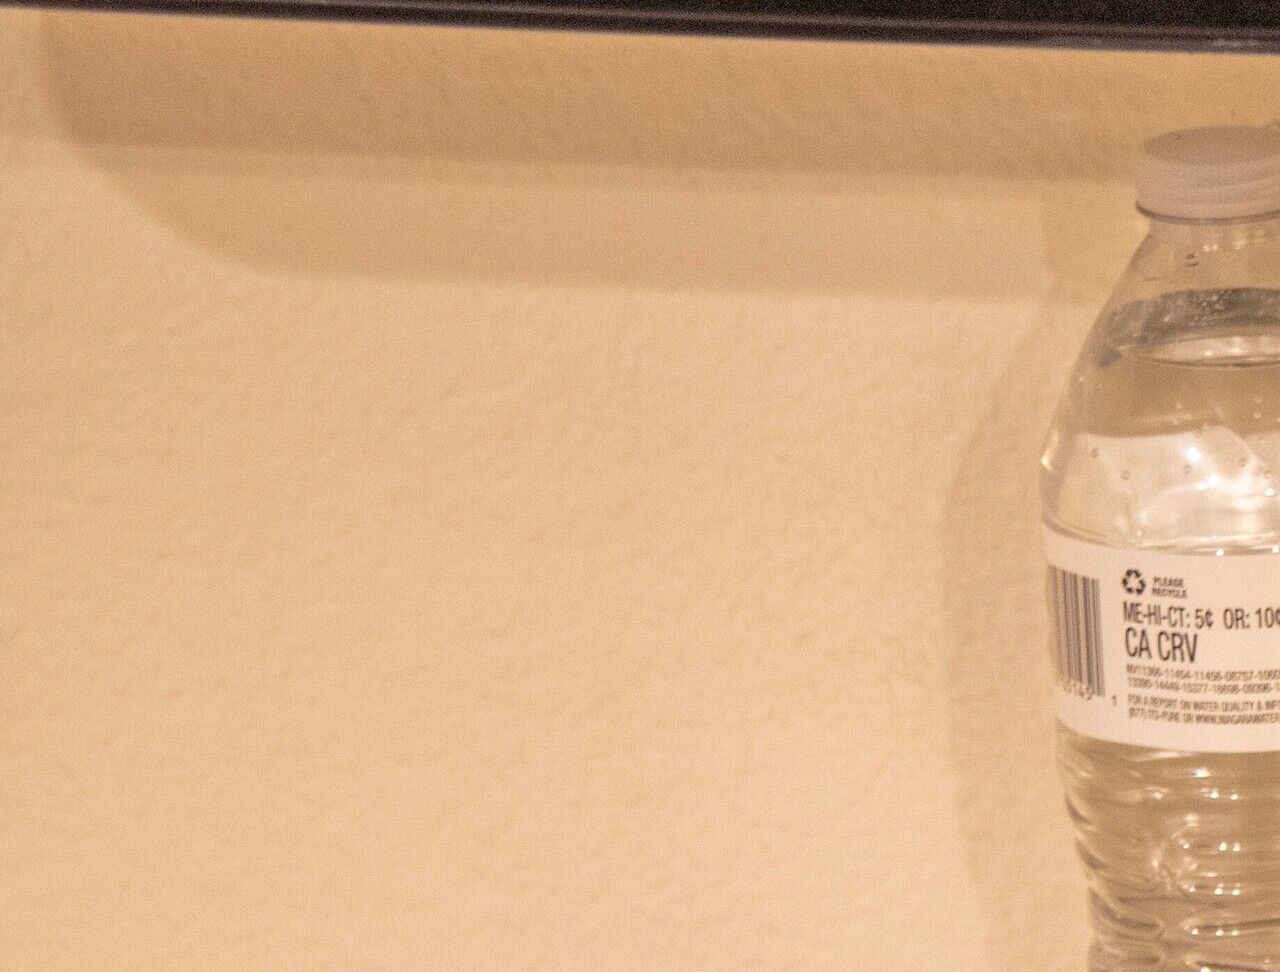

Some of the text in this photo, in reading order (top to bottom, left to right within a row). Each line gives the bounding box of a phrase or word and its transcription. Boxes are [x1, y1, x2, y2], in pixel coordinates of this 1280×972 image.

[1122, 600, 1191, 628] ME-HI-CT:
[1194, 608, 1214, 629] 5¢
[1223, 608, 1251, 630] OR:
[1125, 627, 1198, 663] CA CRV
